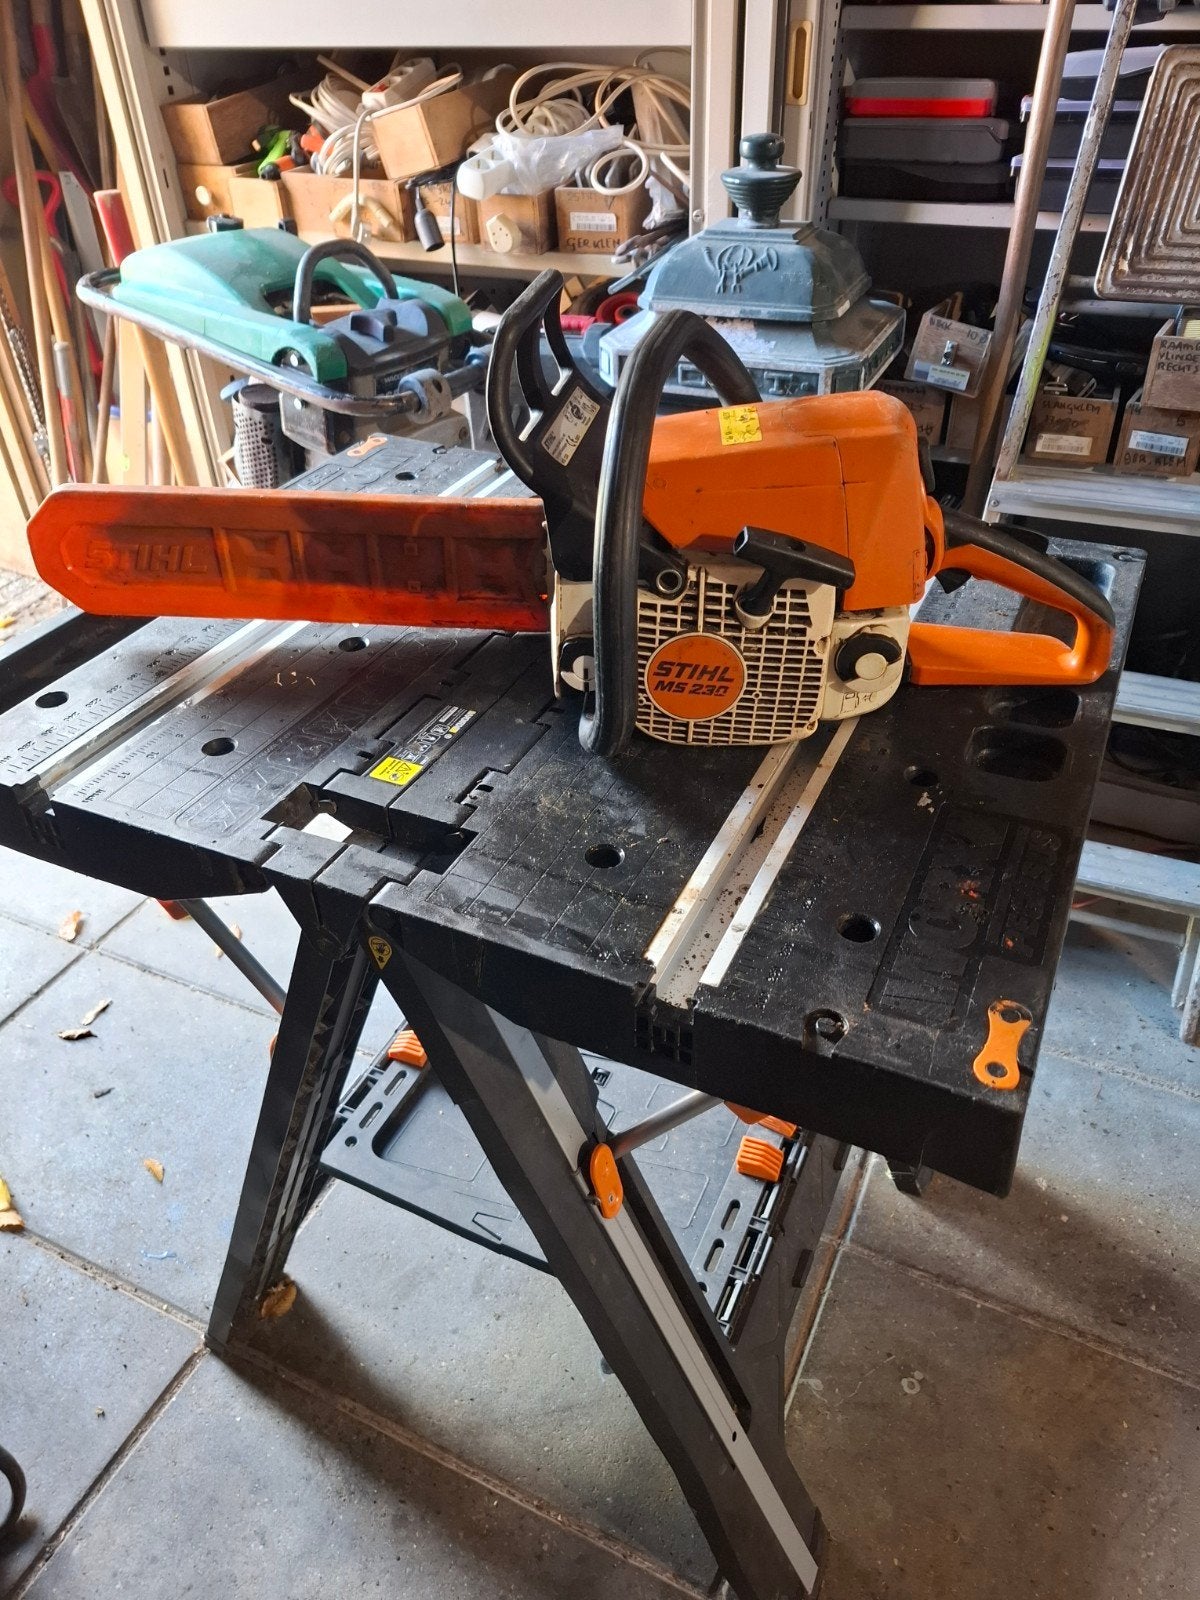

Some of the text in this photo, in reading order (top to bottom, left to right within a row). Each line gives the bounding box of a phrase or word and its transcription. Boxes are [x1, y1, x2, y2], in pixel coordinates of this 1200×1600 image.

[1157, 361, 1199, 374] RECHTS
[85, 541, 208, 574] STIHL
[652, 660, 735, 683] STIHL
[653, 680, 730, 698] MS 230
